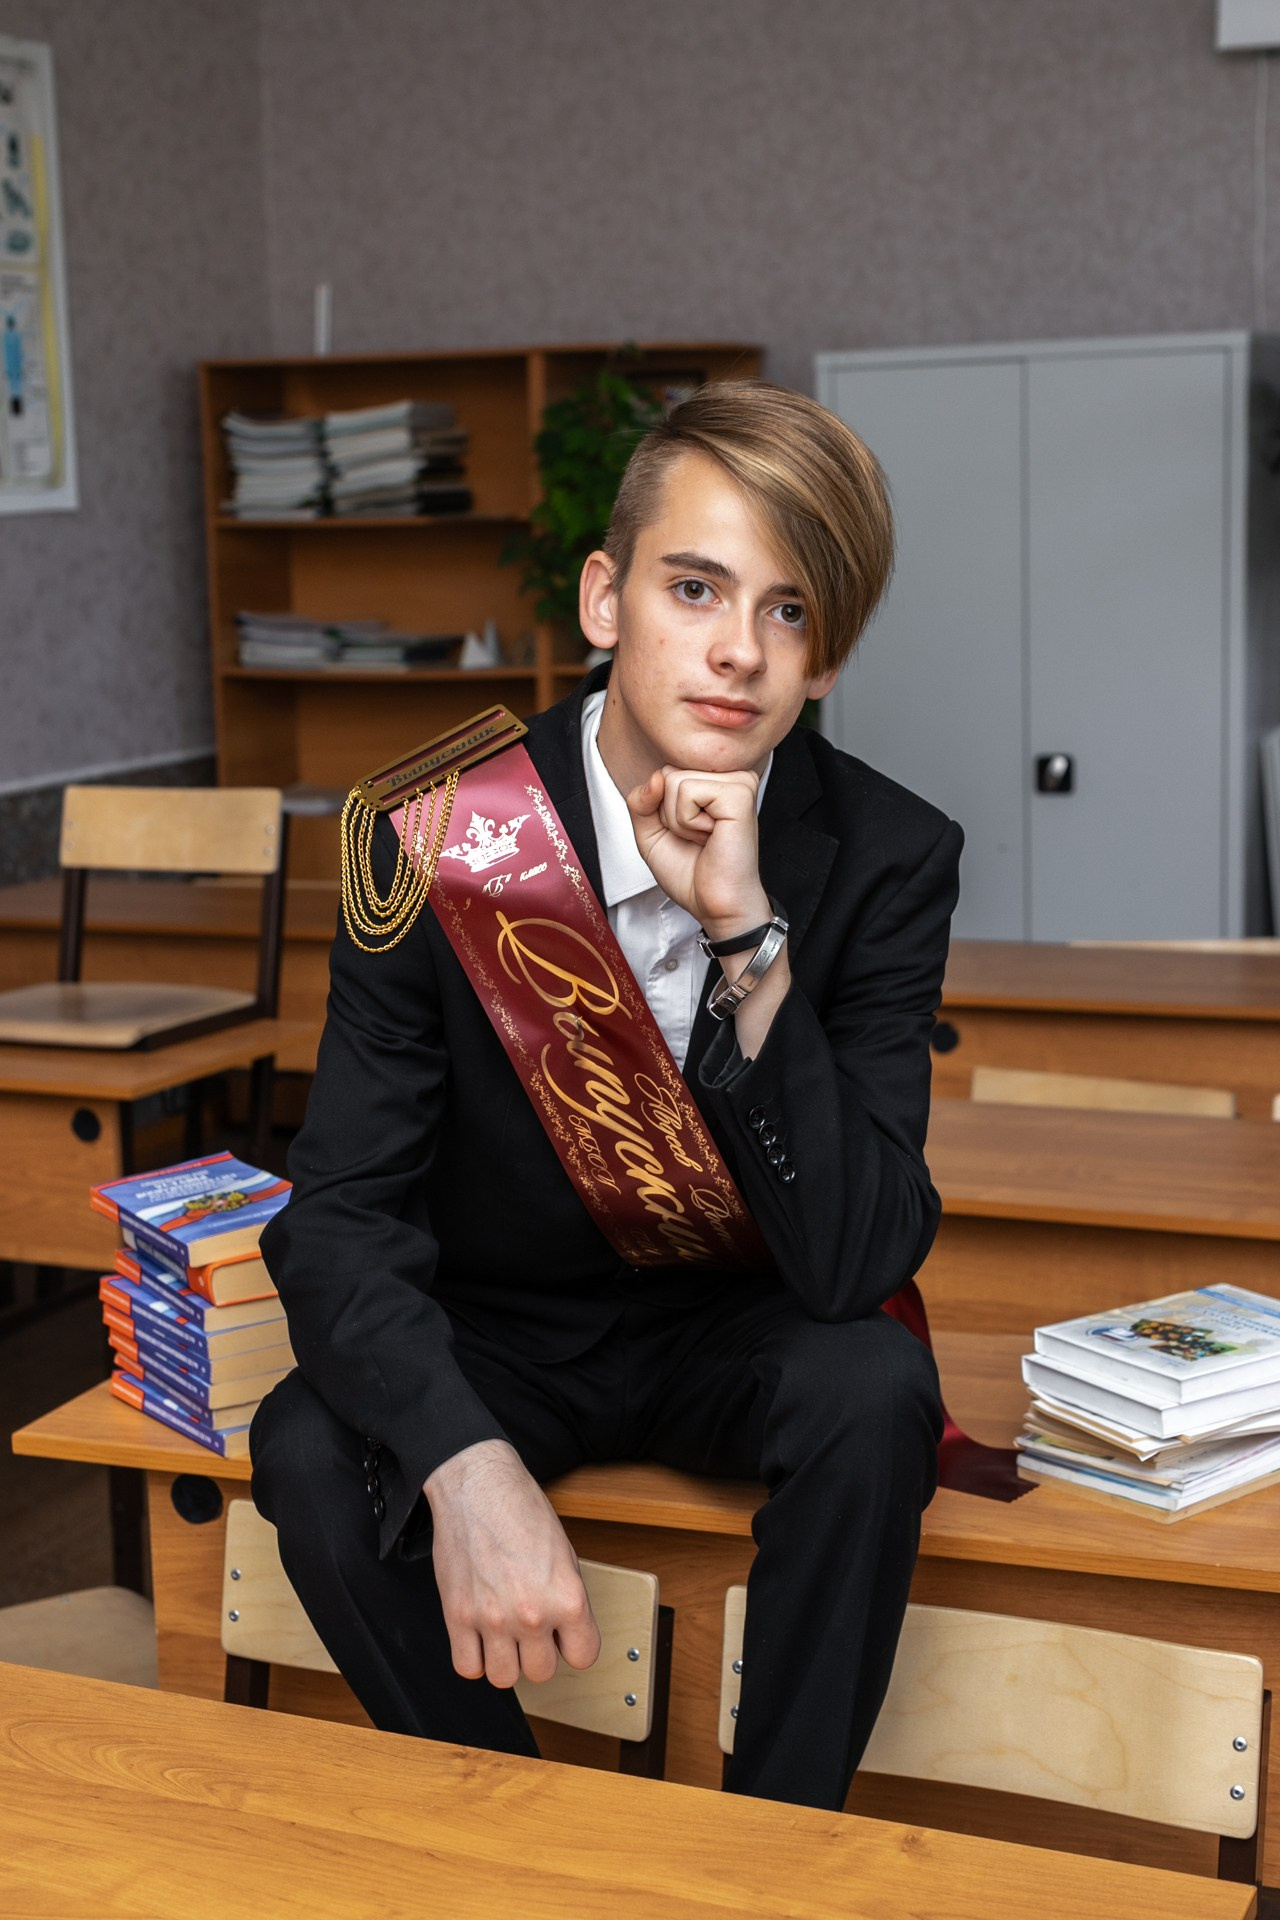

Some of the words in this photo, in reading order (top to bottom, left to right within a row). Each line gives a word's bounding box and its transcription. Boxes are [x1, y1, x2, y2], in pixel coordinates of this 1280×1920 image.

[386, 724, 497, 788] Выпускник
[567, 1113, 622, 1195] МБОУ
[633, 1072, 703, 1173] Авдеев
